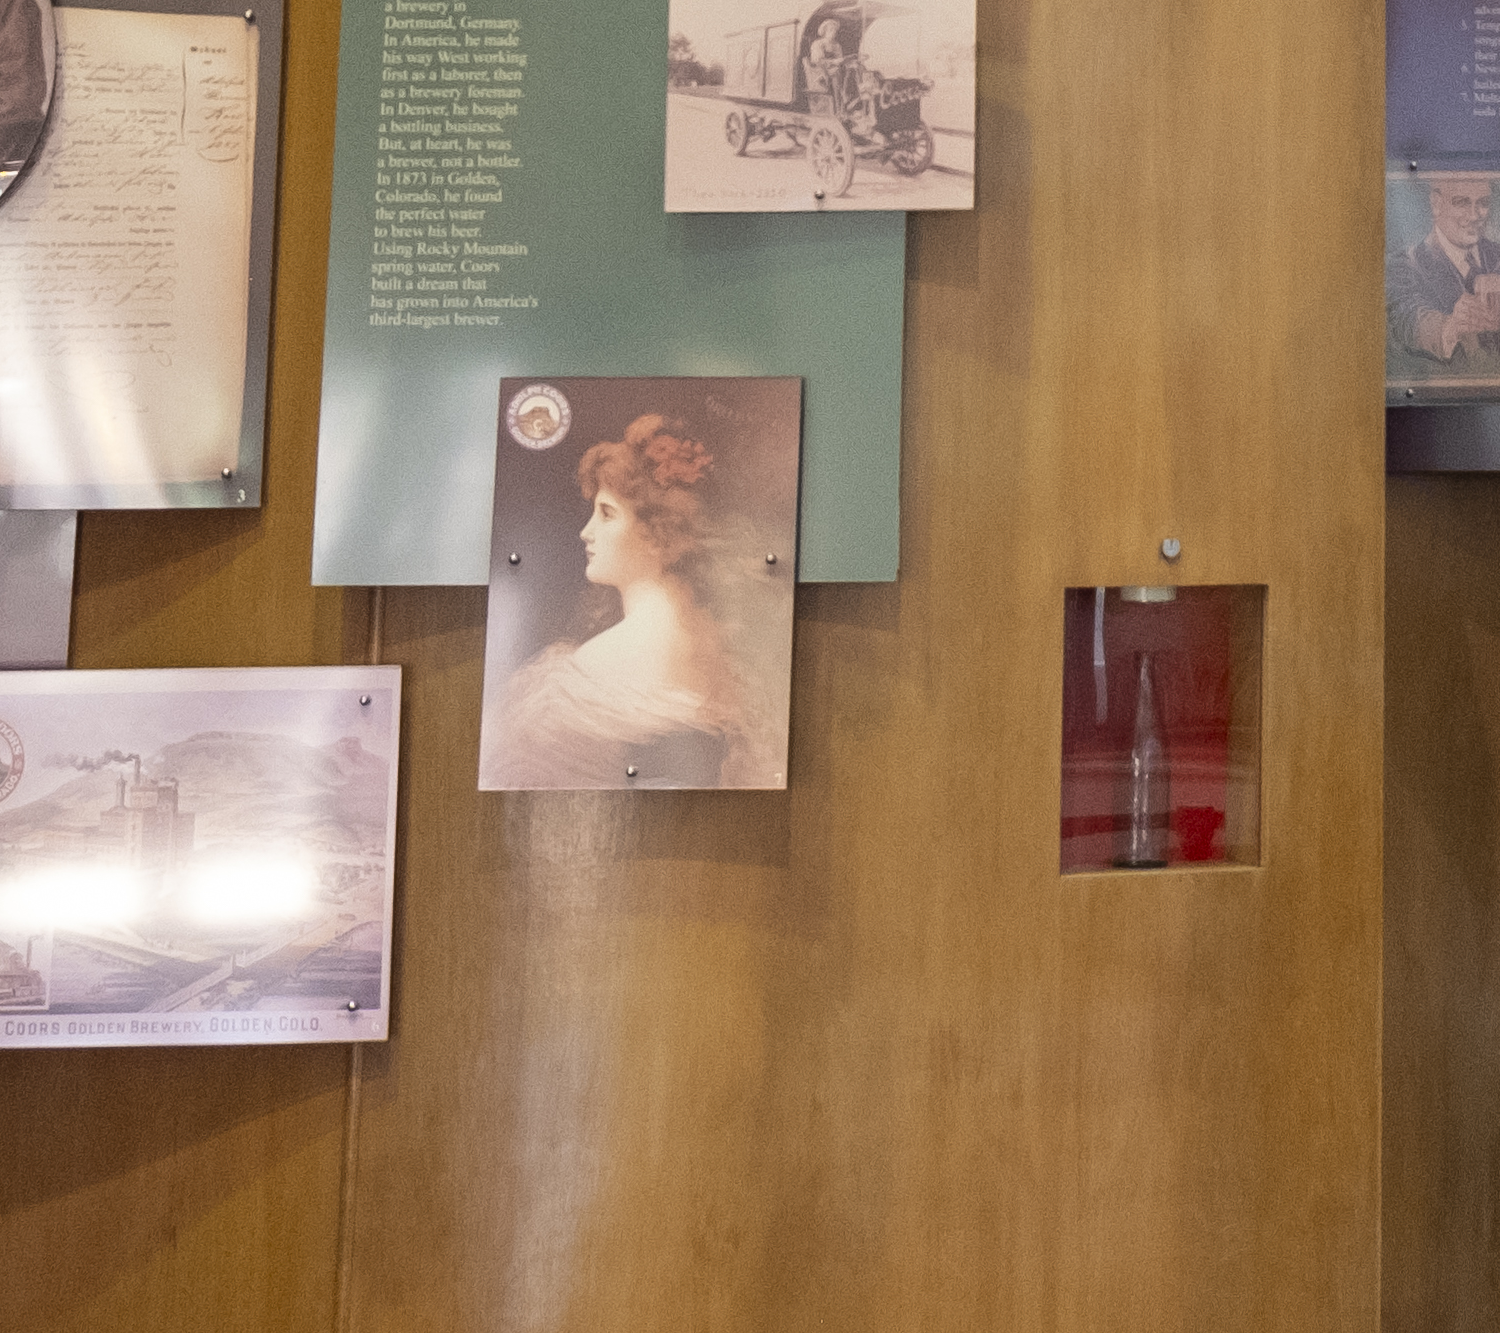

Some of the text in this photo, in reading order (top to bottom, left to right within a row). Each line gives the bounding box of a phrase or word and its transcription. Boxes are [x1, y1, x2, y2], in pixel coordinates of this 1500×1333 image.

[373, 242, 528, 258] Using Rocky Mountain
[4, 1020, 62, 1037] COORS
[67, 1021, 125, 1035] GOLDEN
